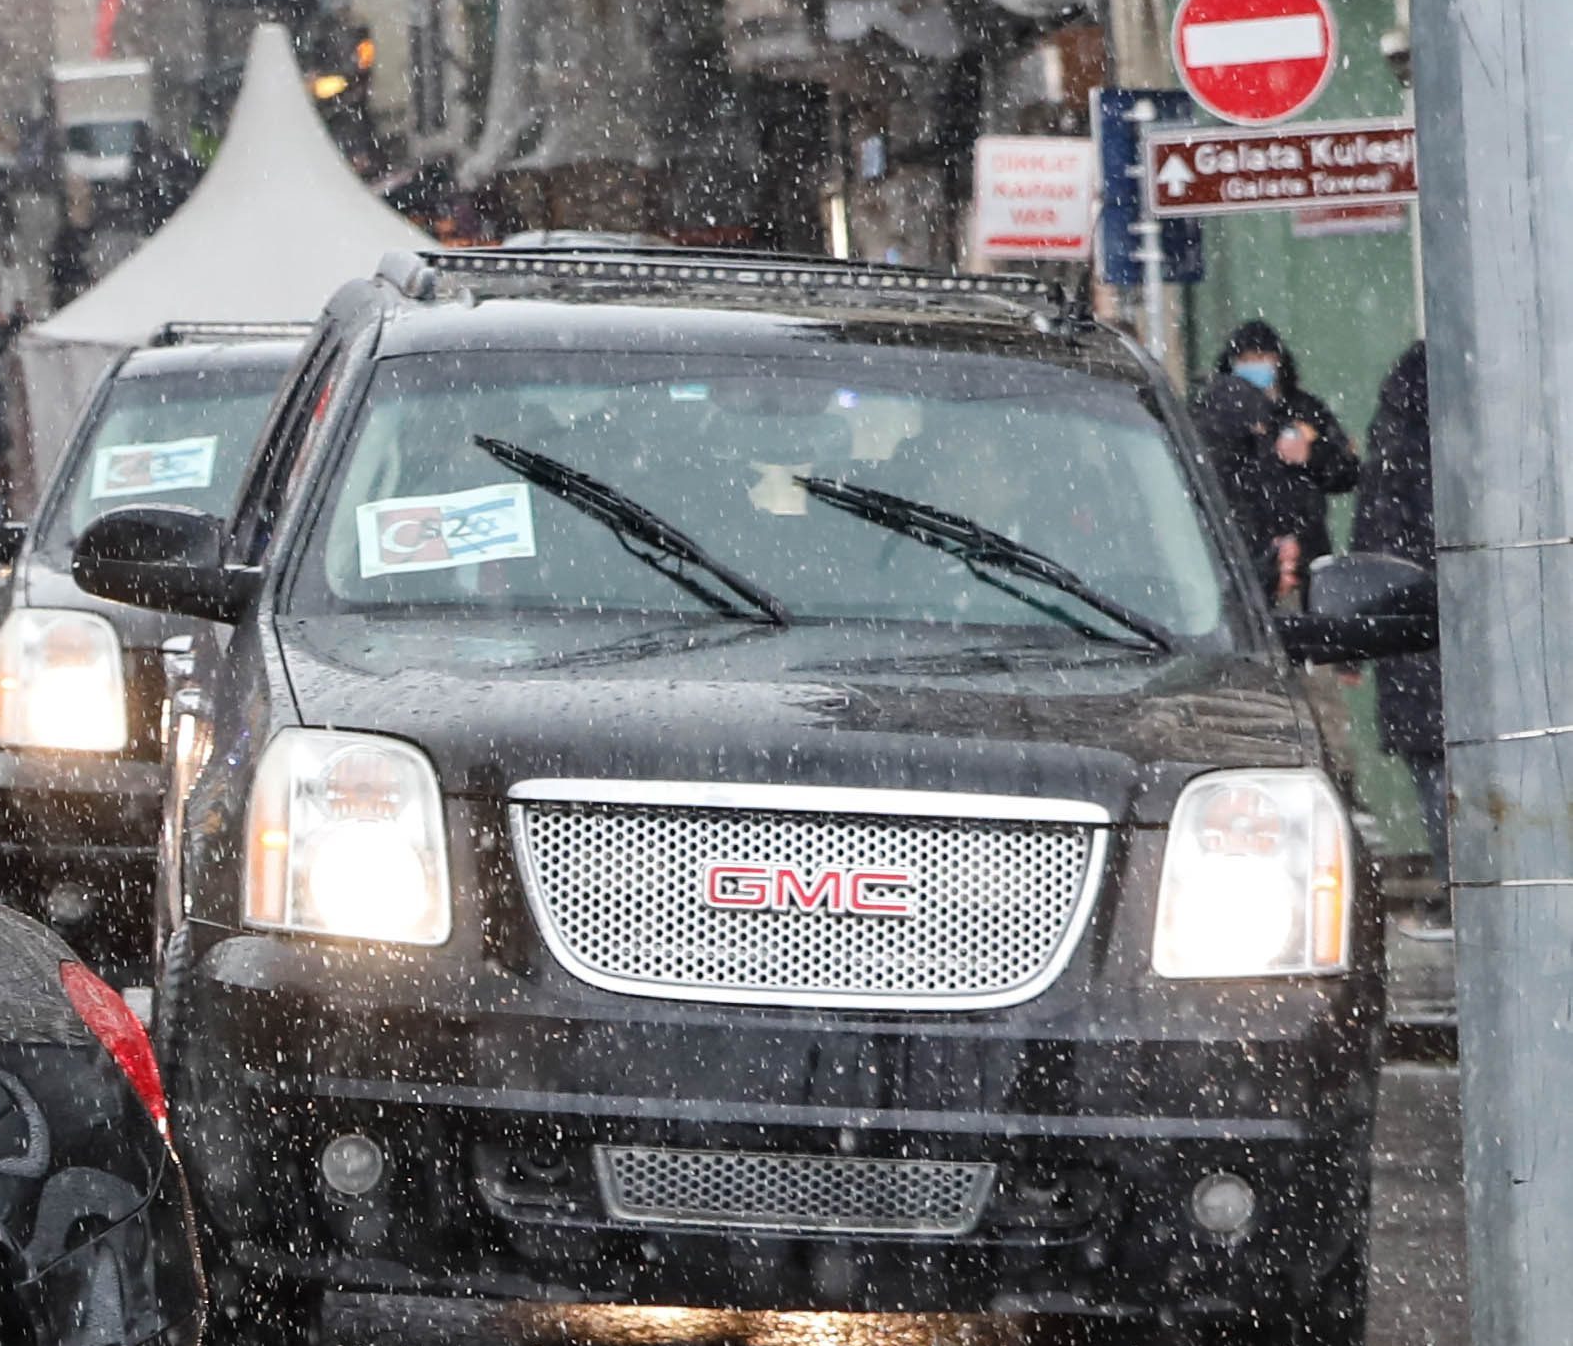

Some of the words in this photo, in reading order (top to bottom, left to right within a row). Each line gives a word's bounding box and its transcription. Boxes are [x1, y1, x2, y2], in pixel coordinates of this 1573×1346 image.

[1194, 142, 1304, 175] Galata
[1309, 135, 1411, 167] Kulesi
[704, 861, 914, 916] GMC
